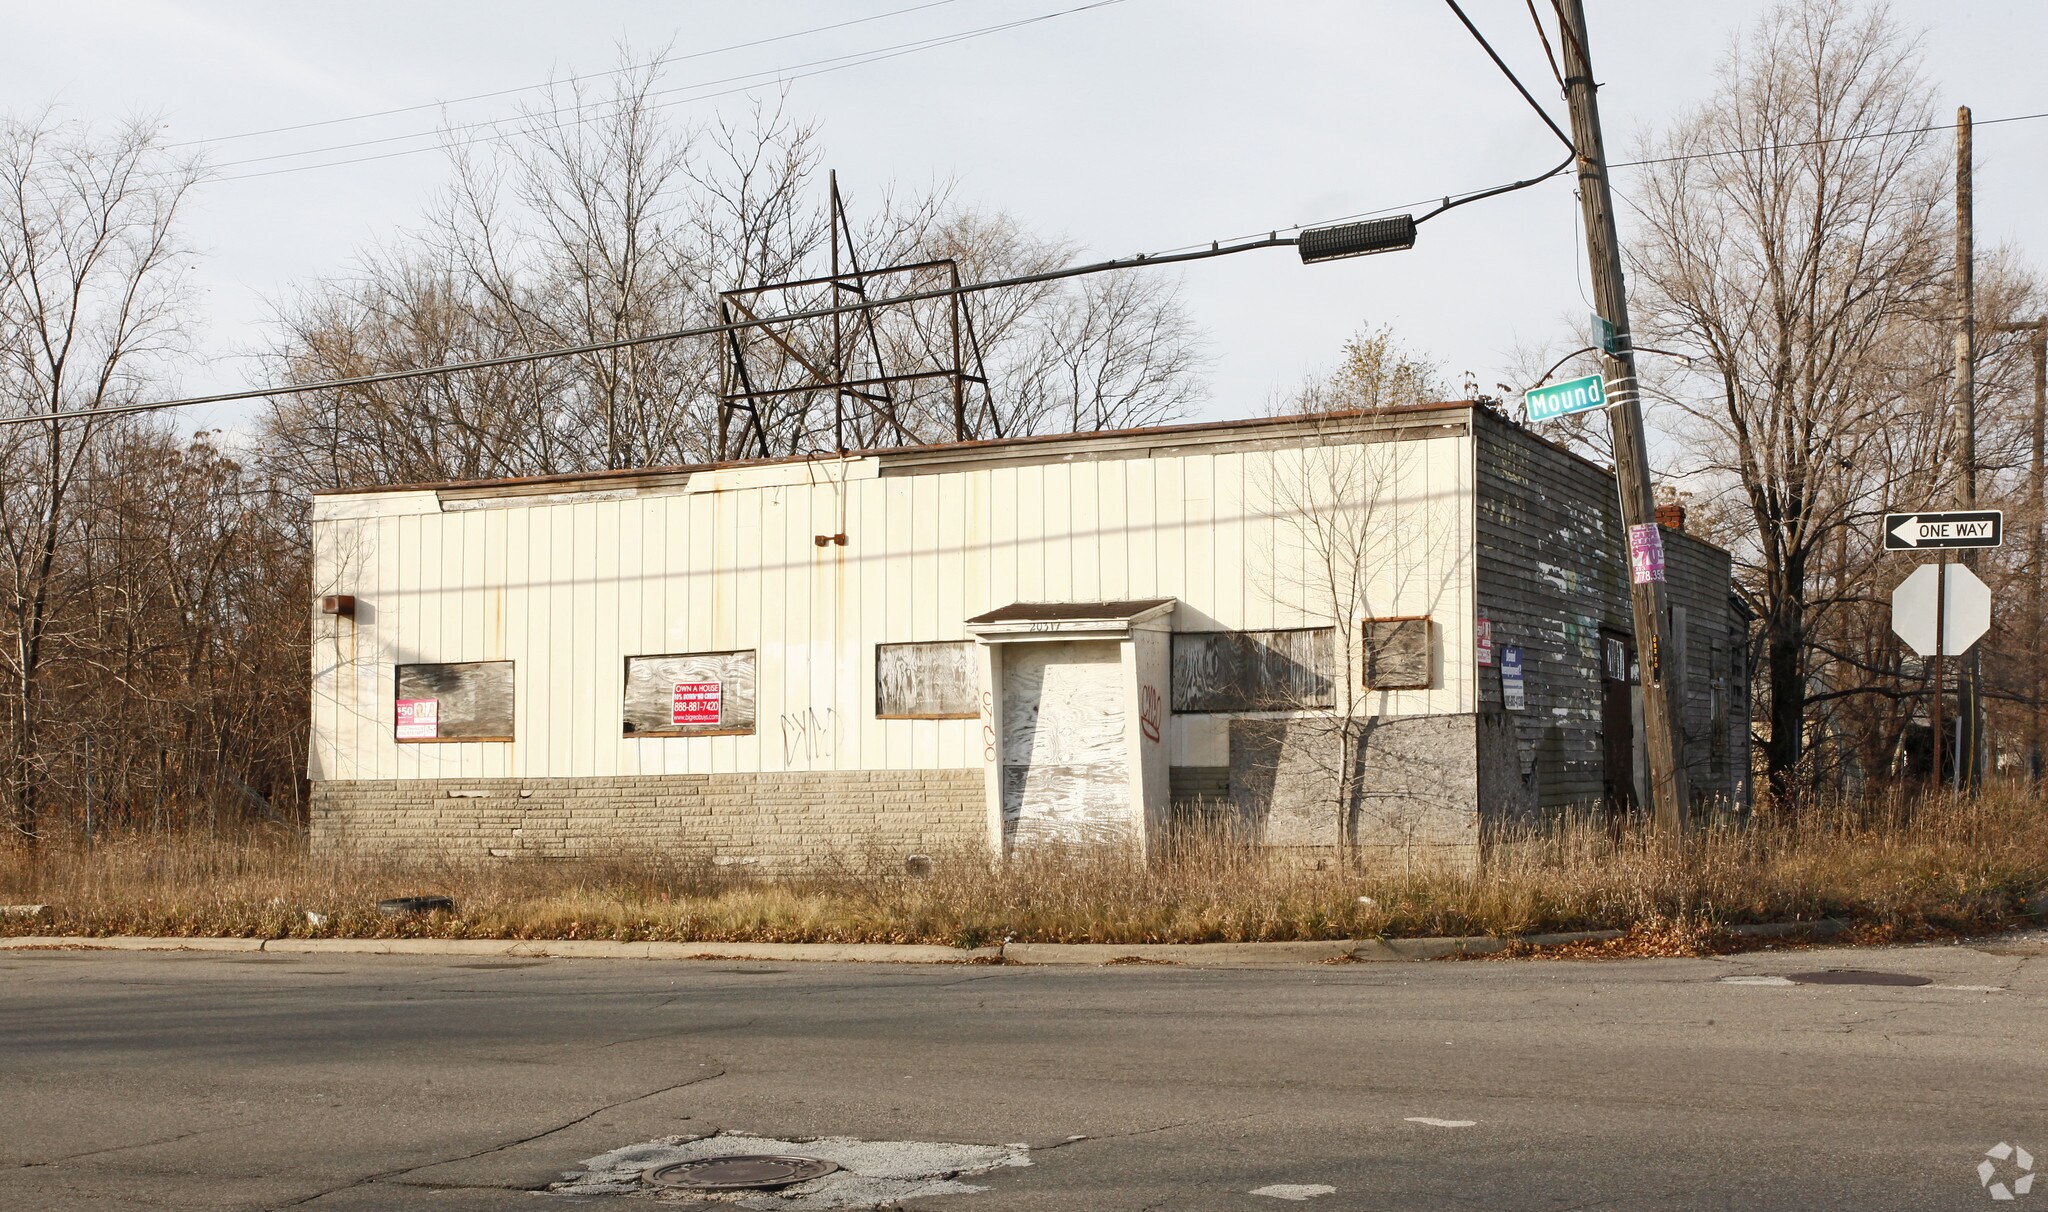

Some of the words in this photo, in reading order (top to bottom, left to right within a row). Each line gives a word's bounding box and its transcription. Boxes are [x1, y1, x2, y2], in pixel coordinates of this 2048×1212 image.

[1531, 379, 1600, 417] Mound
[1919, 524, 1950, 538] ONE
[1956, 523, 1988, 537] WAY
[699, 684, 719, 692] HOUSE
[397, 706, 413, 716] $50
[674, 701, 719, 712] 888-881-7420
